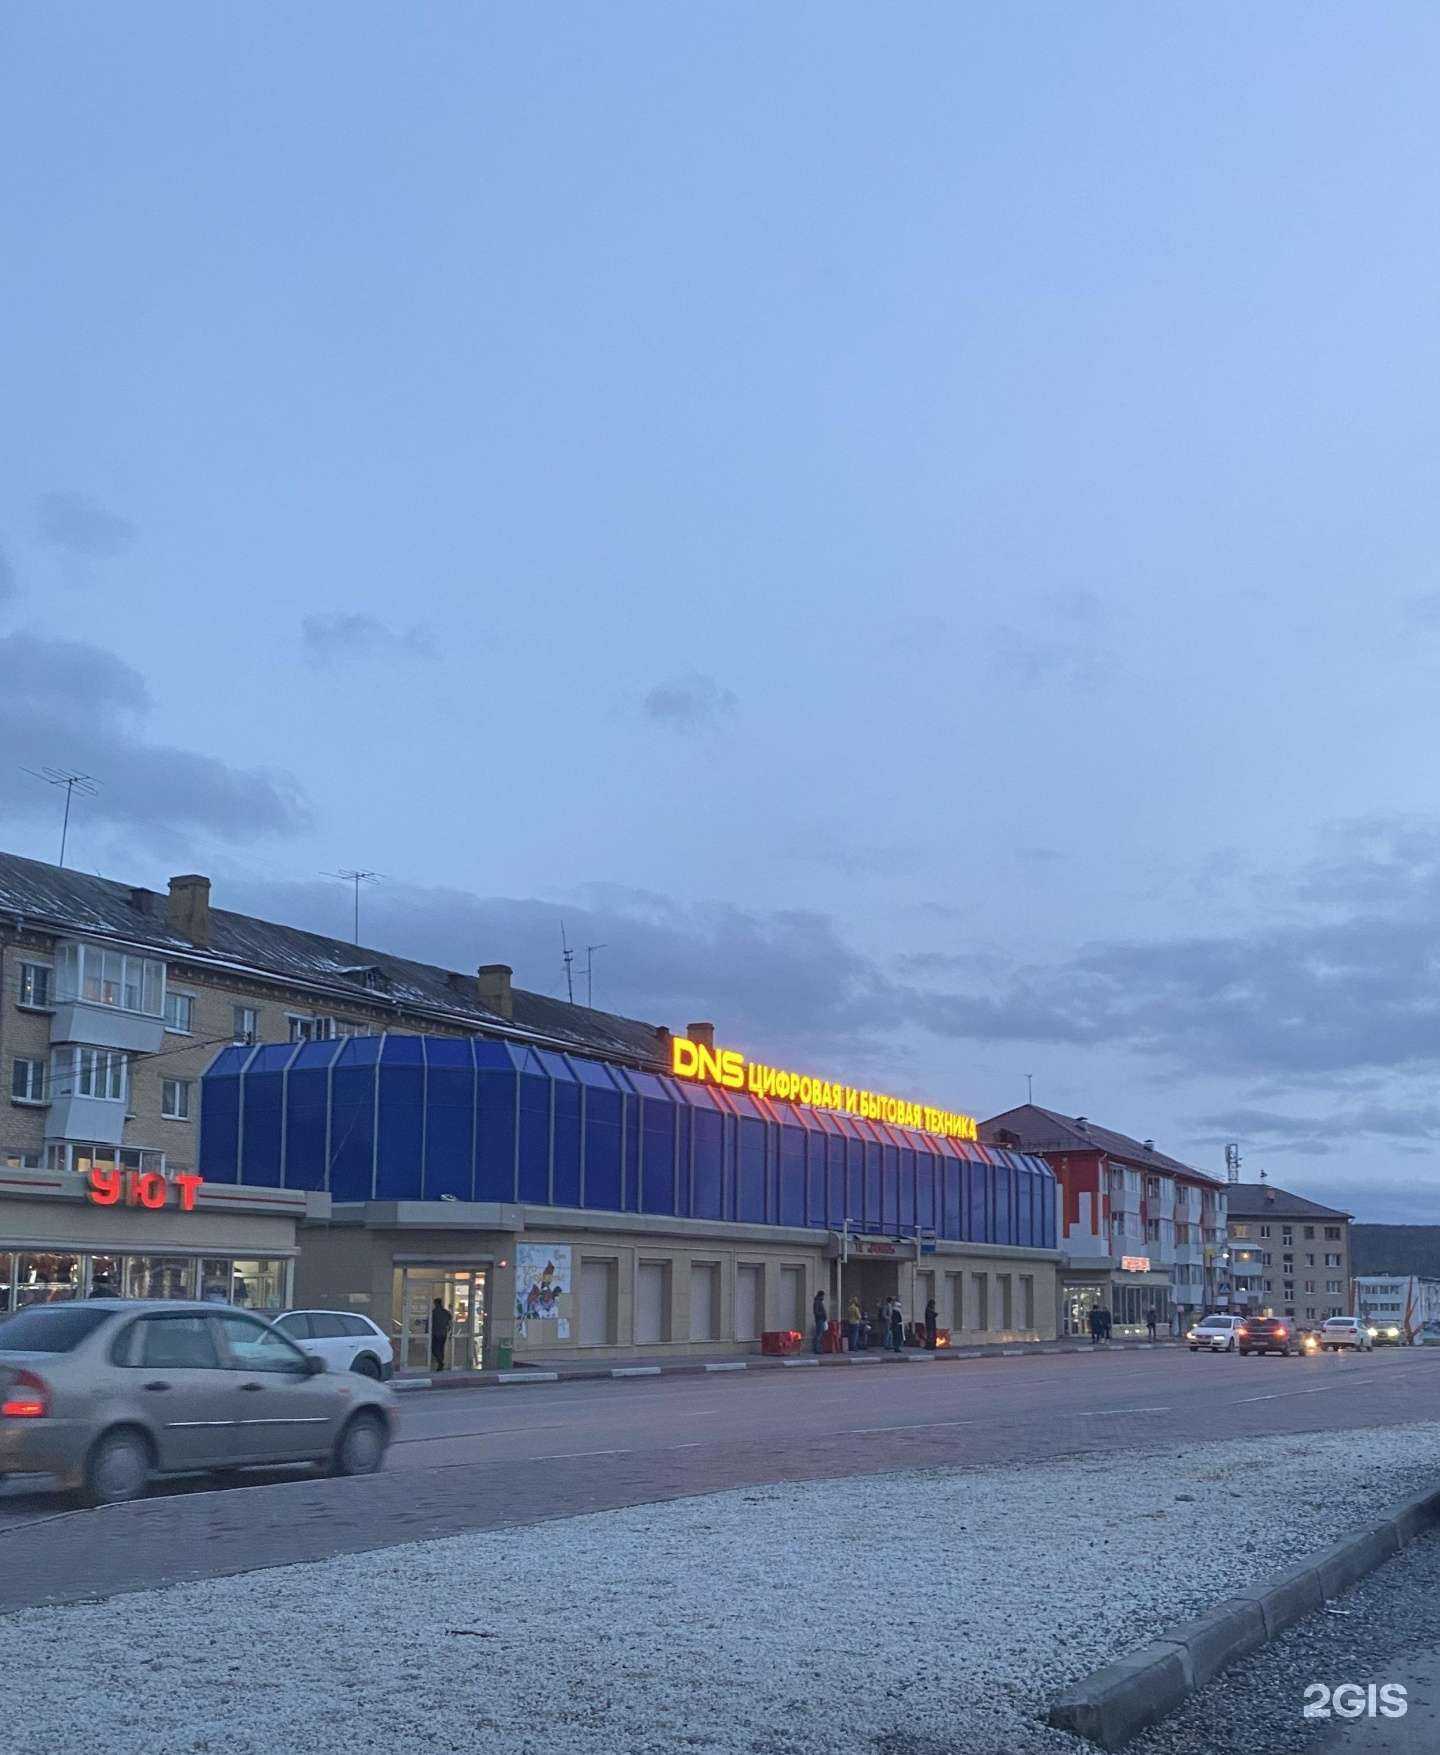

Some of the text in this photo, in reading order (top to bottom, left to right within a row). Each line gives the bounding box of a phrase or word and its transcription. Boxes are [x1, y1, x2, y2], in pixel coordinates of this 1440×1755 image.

[672, 1036, 744, 1087] DNS
[749, 1063, 977, 1140] ЦИФРОВАЯ И БЫТОВАЯ ТЕХНИКА
[90, 1168, 203, 1211] УЮТ
